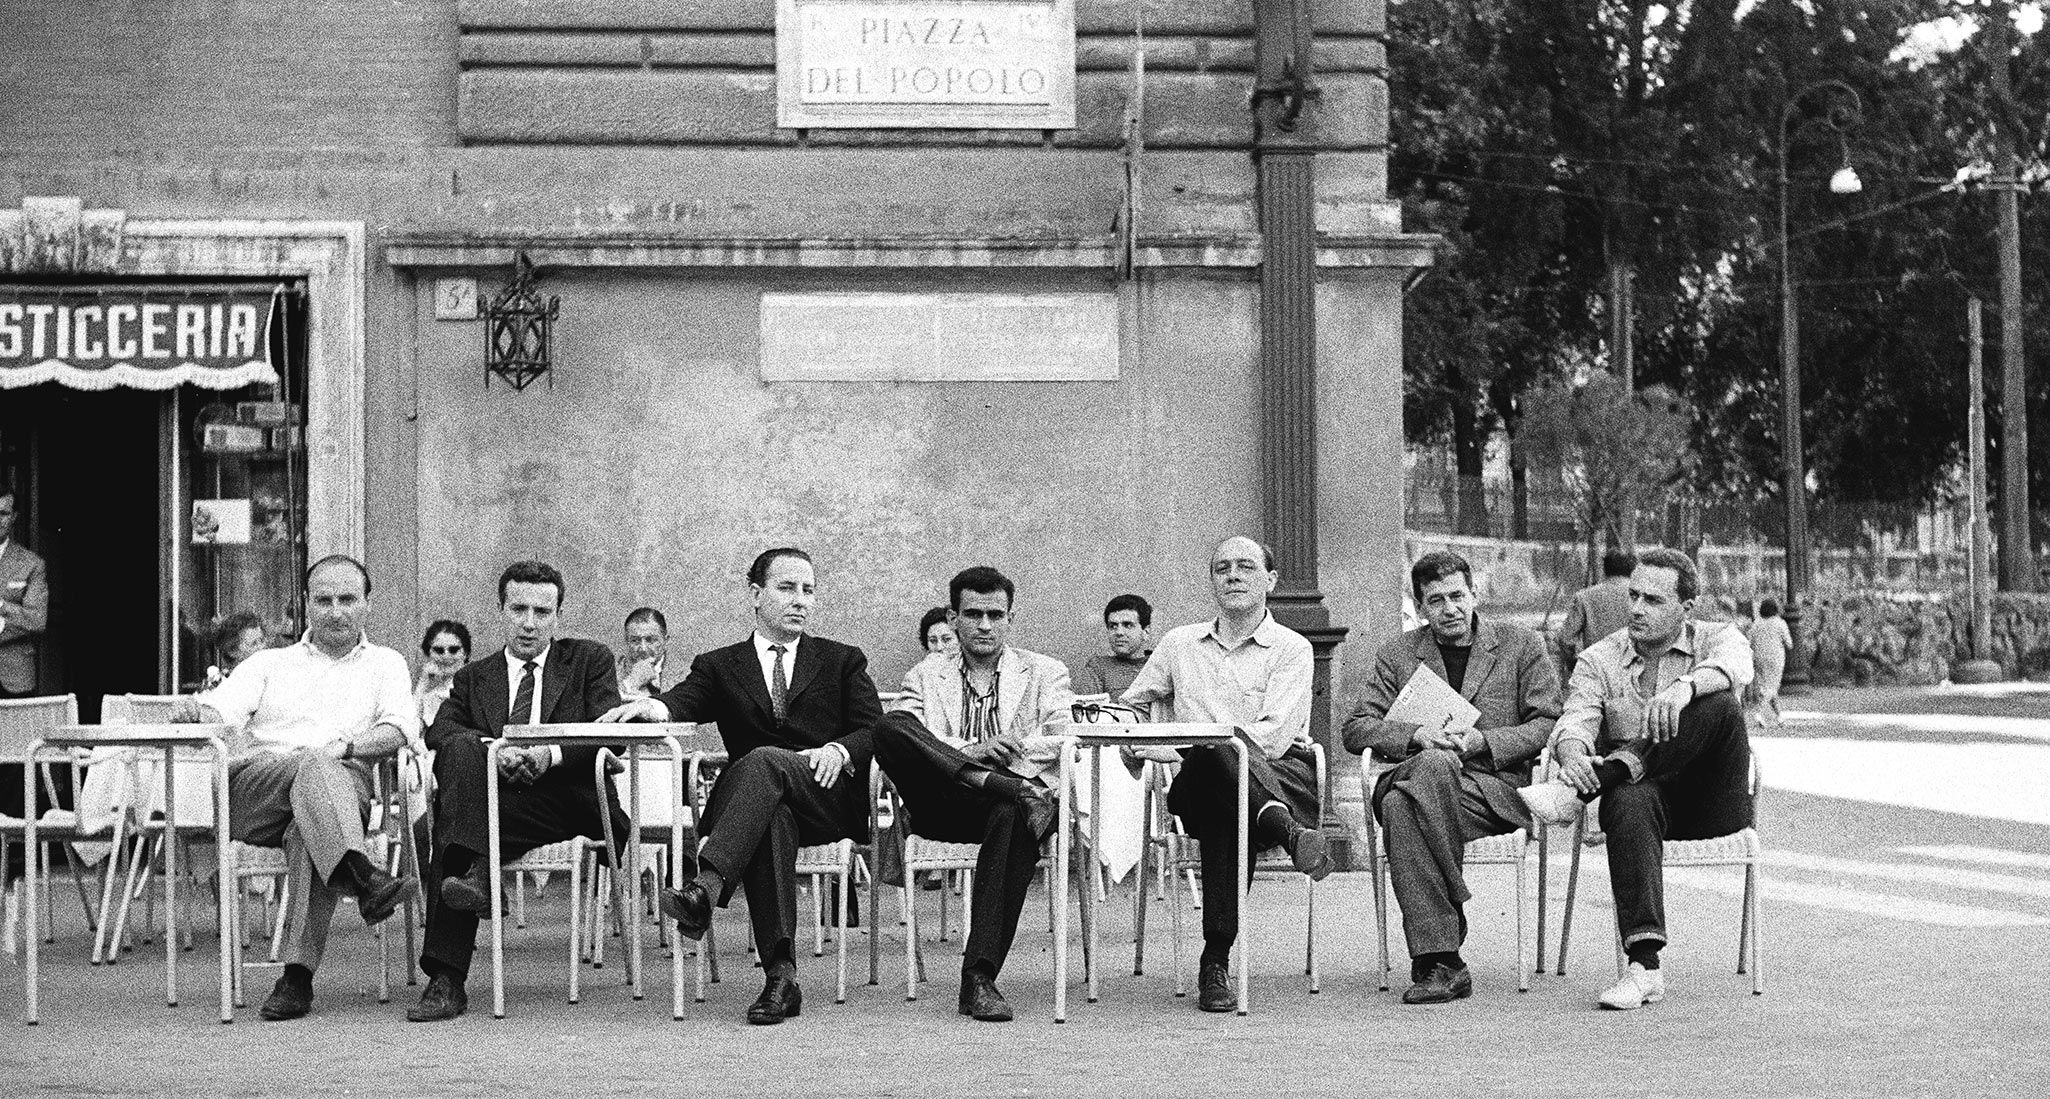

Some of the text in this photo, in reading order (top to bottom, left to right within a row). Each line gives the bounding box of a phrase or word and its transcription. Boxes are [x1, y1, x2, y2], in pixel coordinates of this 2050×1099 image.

[862, 17, 989, 44] PIAZZA
[808, 67, 1046, 95] DEL POPOLO
[0, 303, 256, 359] STICCERIA
